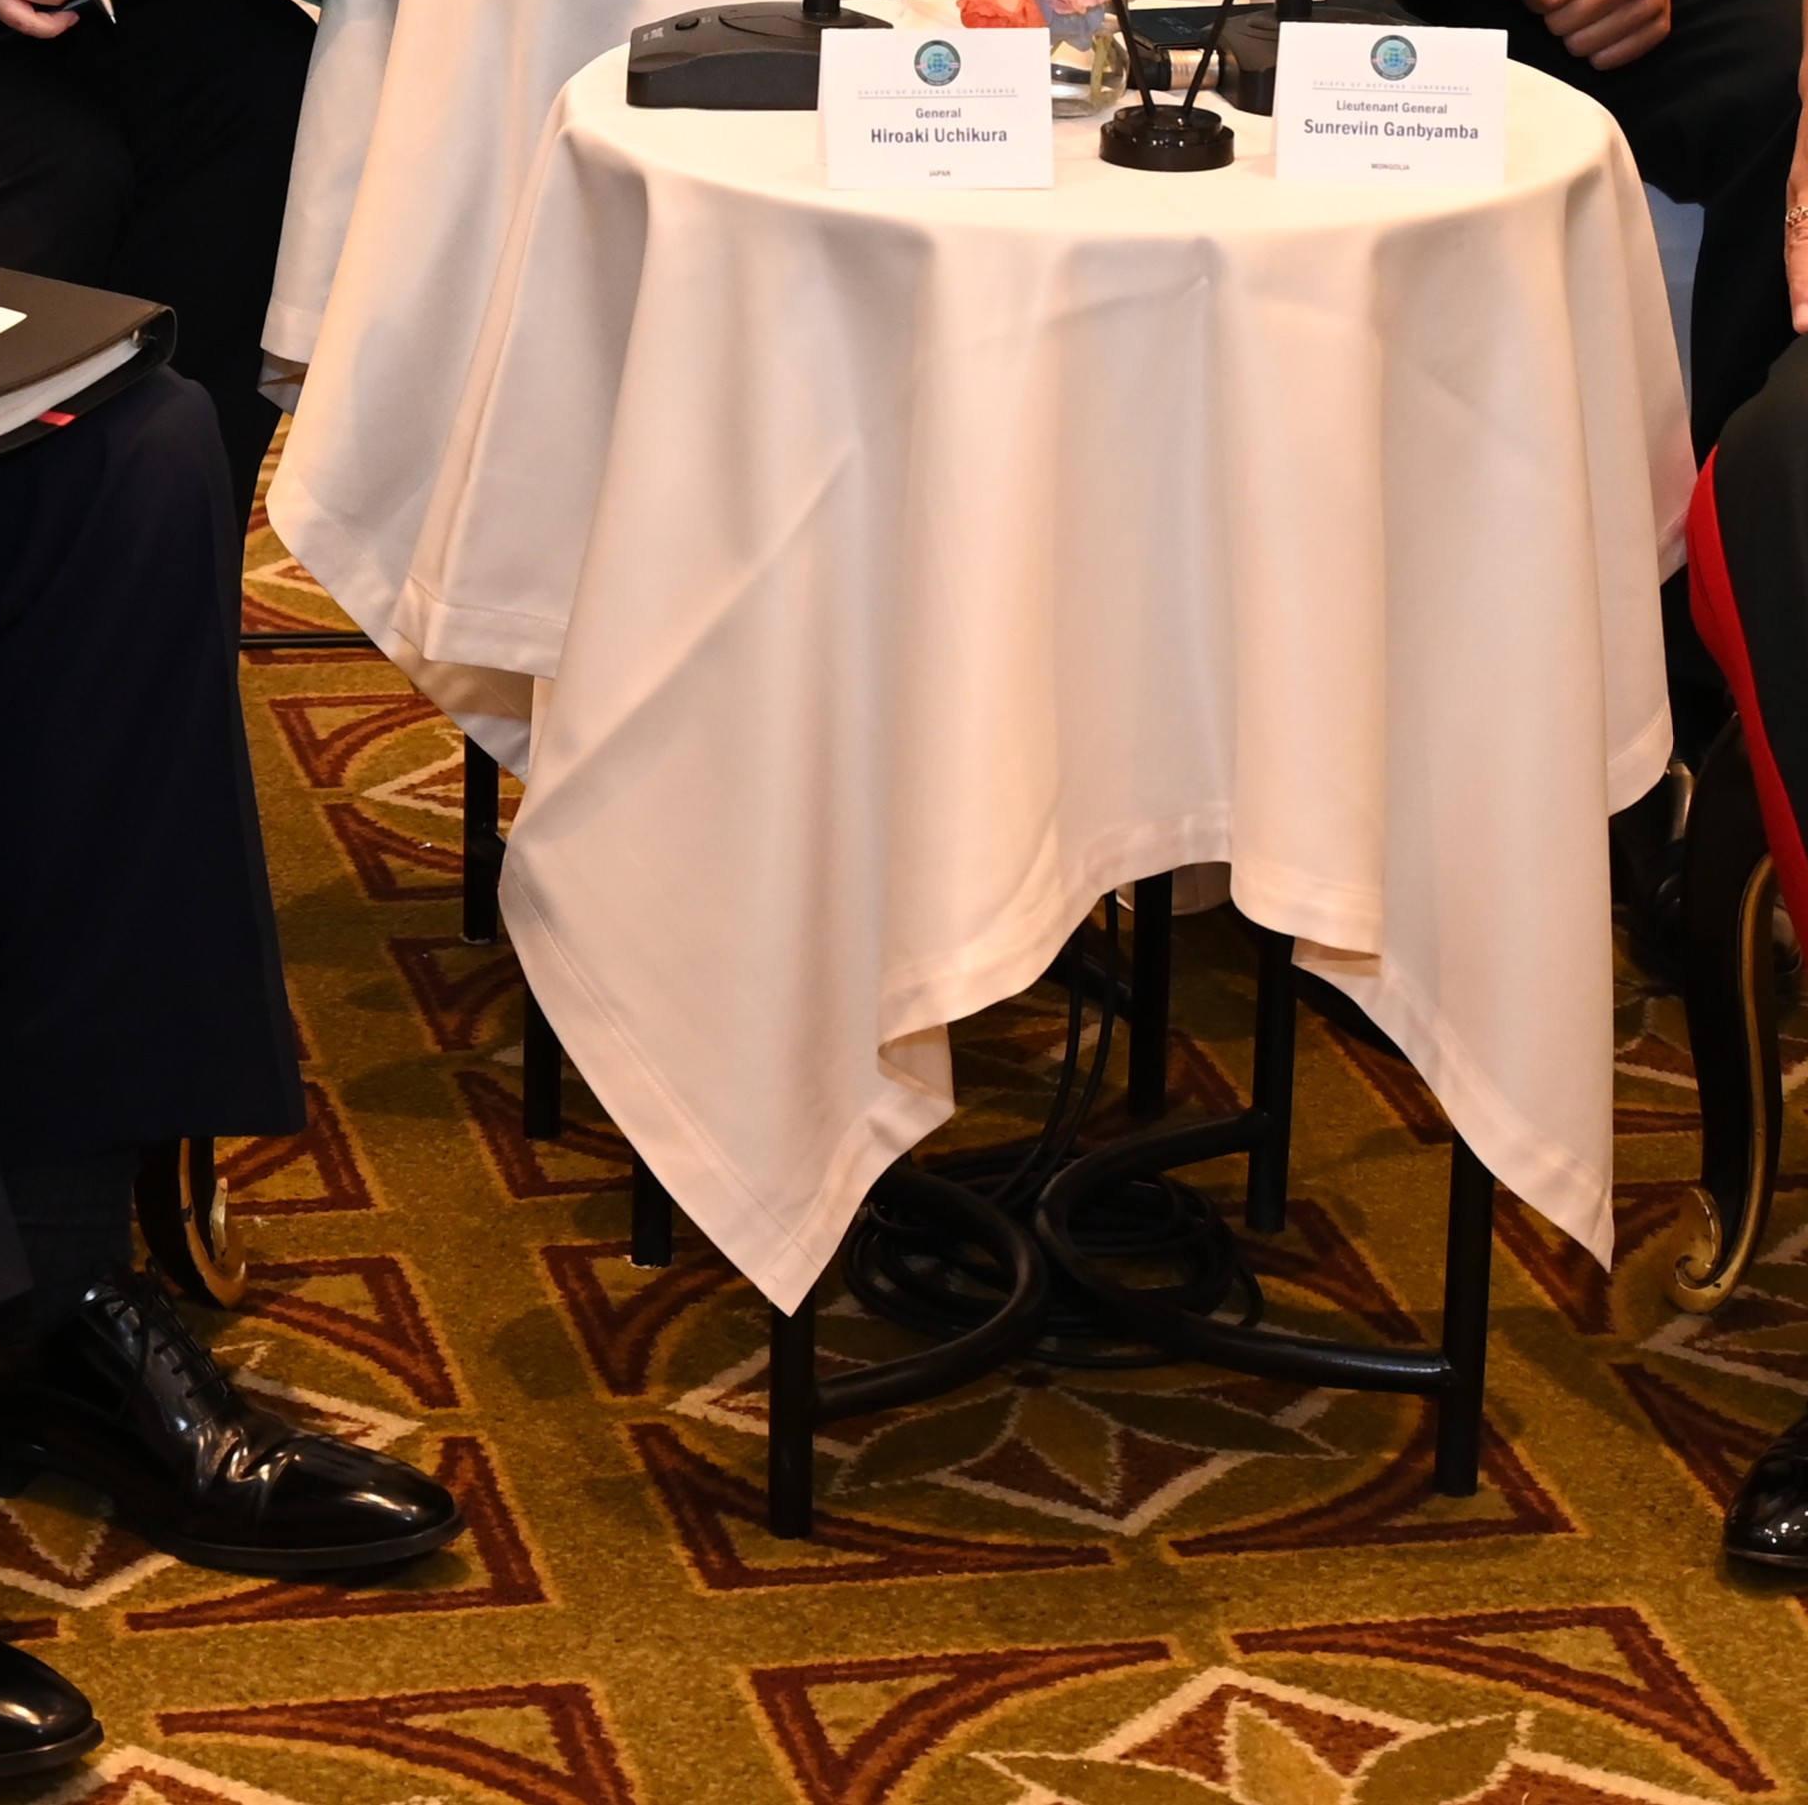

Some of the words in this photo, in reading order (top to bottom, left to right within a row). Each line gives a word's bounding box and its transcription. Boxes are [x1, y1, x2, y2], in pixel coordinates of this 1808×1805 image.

[915, 107, 961, 119] General
[1336, 100, 1399, 113] Lieutenant
[1402, 102, 1448, 114] General
[871, 128, 929, 143] Hiroaki
[935, 127, 1007, 142] Uchikura
[1304, 118, 1379, 136] Sunreviin
[1384, 121, 1479, 141] Ganbyamba
